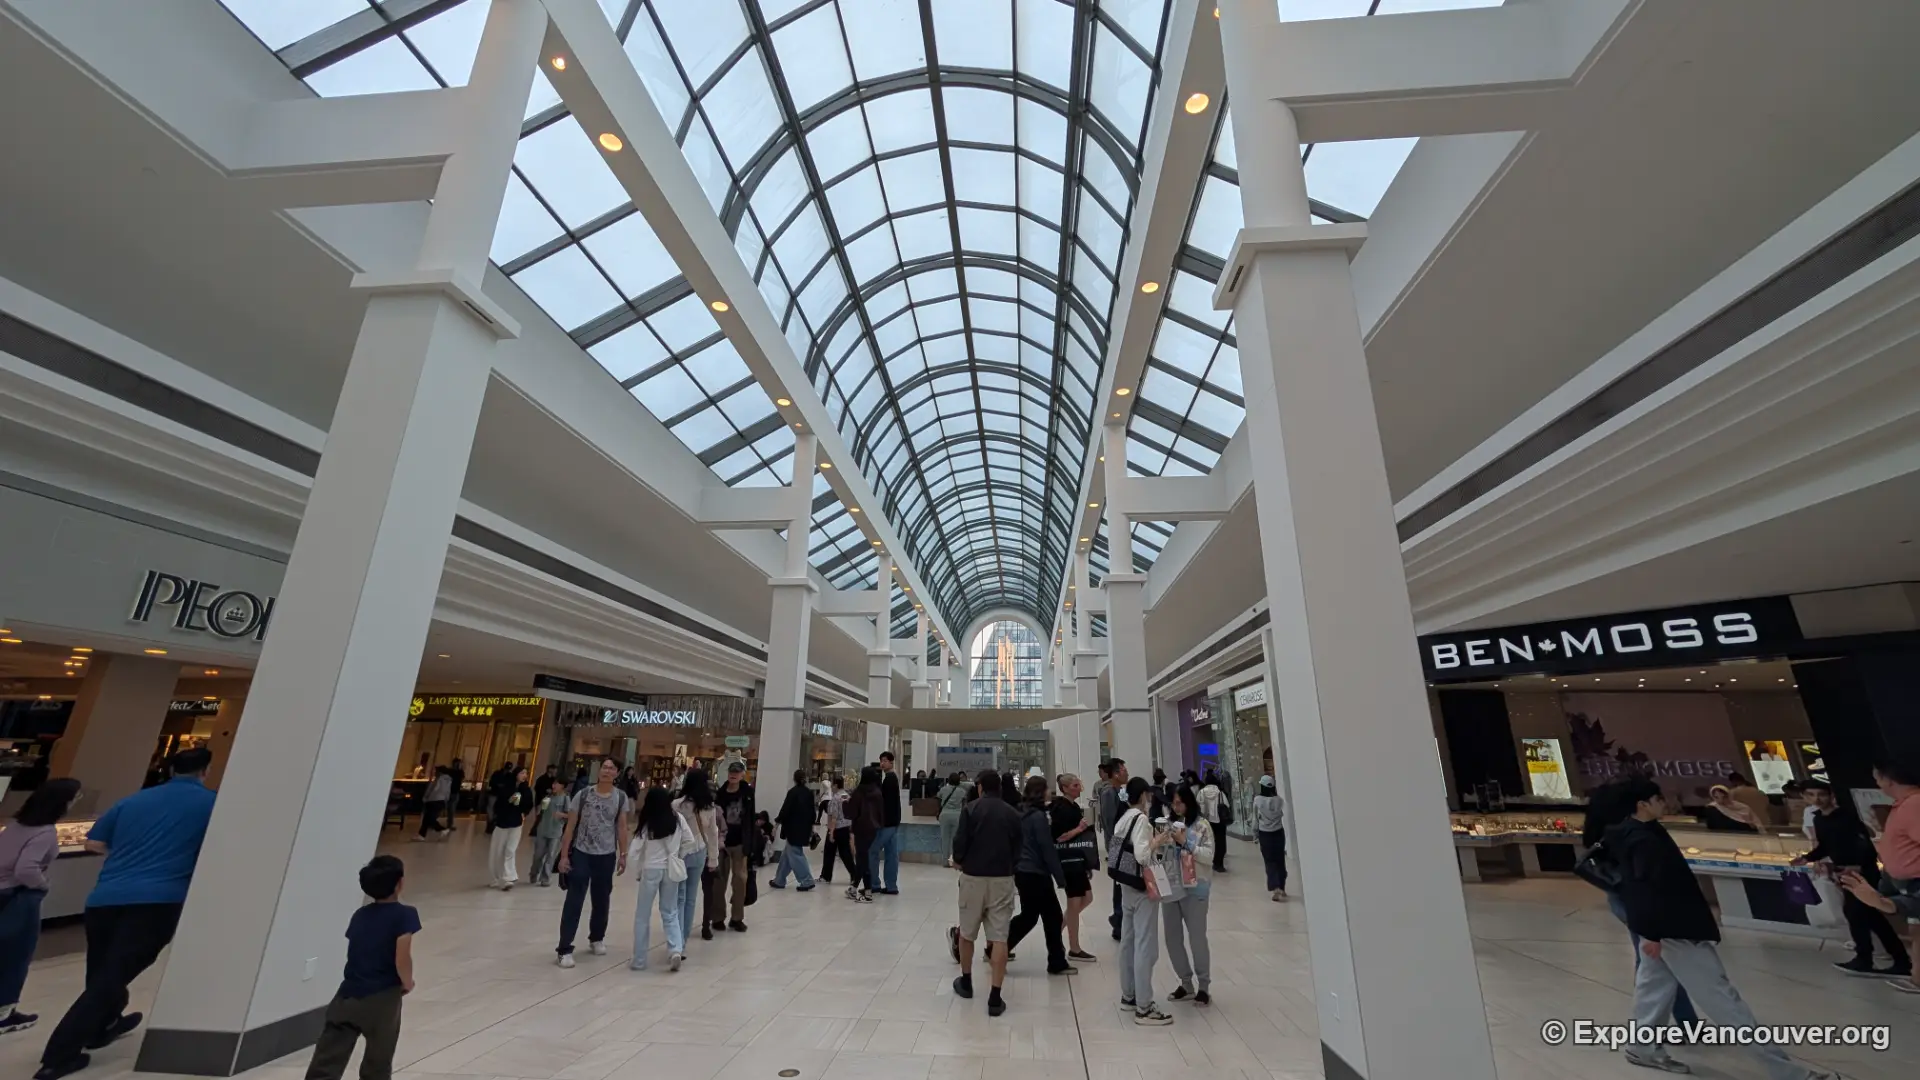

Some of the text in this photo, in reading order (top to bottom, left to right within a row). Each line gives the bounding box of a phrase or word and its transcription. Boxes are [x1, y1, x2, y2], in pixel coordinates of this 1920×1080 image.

[1432, 612, 1758, 669] BEN MOSS
[429, 696, 542, 706] LAO FENG XIANG JEWELRY
[621, 710, 696, 724] SWAROVSKI
[1653, 760, 1735, 778] MOSS
